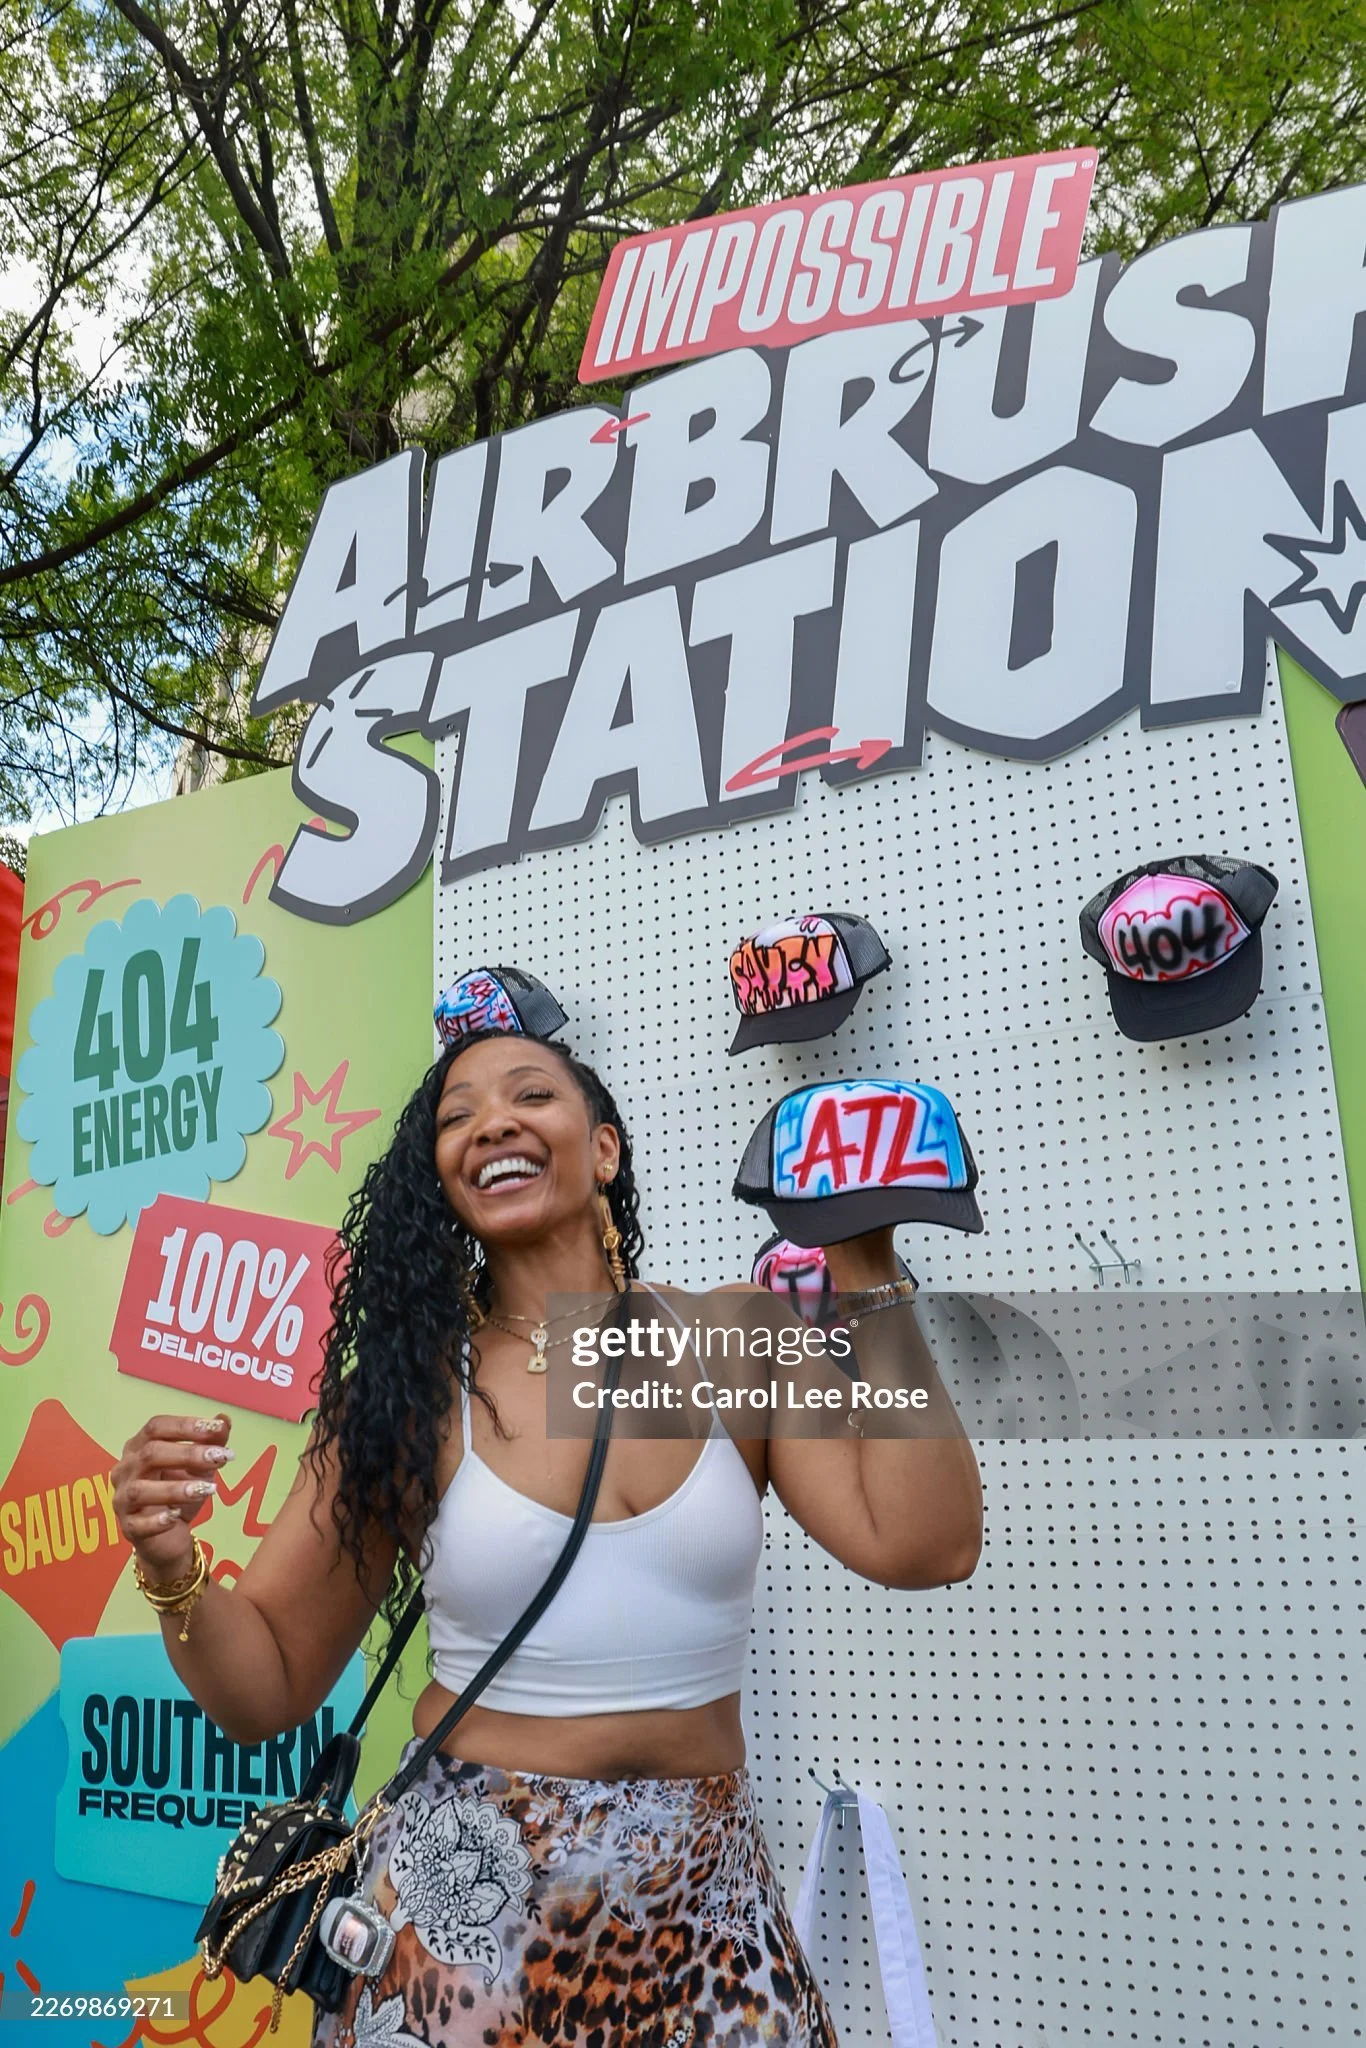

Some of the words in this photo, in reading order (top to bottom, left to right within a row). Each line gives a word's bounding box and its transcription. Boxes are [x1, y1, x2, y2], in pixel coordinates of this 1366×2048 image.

[594, 161, 1077, 367] IMPOSSIBLE
[278, 402, 1366, 908] STATION
[1118, 903, 1225, 976] 404
[73, 937, 220, 1092] 404
[73, 1066, 223, 1178] ENERGY
[792, 1095, 948, 1189] ATL
[145, 1226, 311, 1358] 100%
[141, 1327, 294, 1388] DELICIOUS
[0, 1471, 119, 1576] SAUCY
